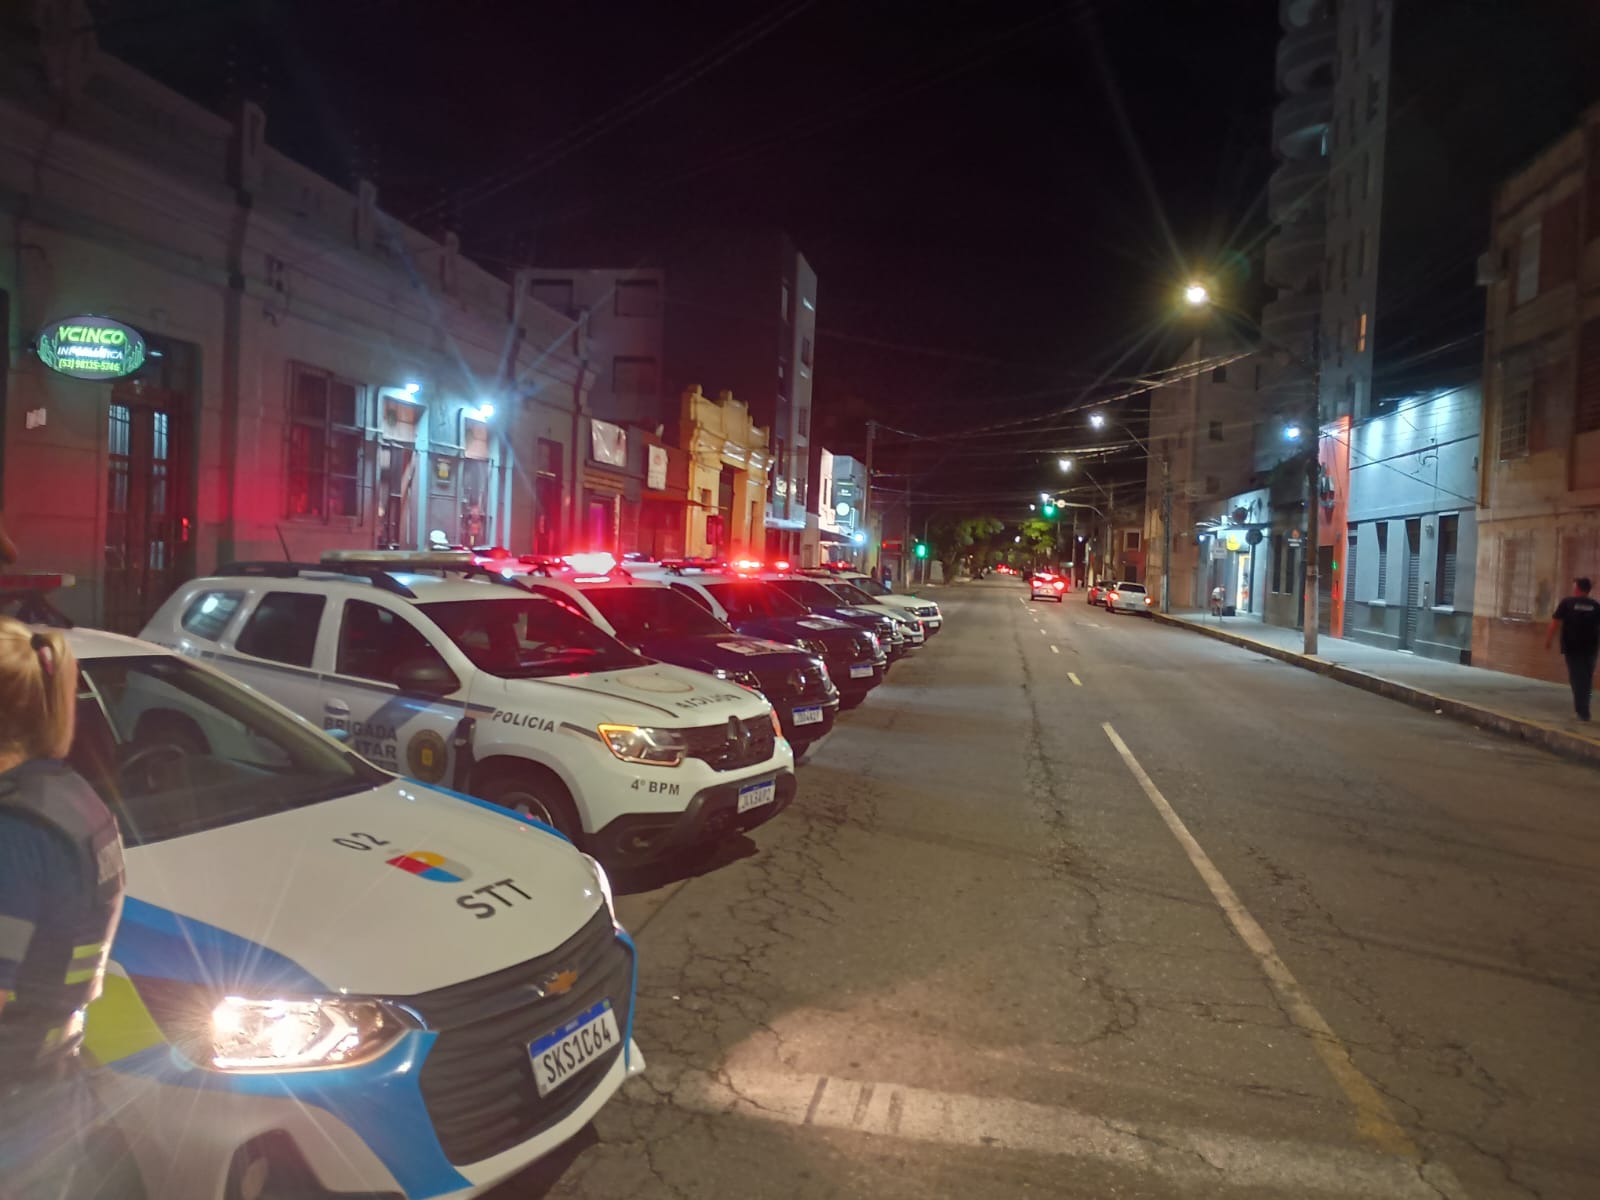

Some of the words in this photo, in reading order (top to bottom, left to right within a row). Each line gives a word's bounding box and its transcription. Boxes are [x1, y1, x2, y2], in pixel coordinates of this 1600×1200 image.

[59, 326, 124, 344] VCINCO
[492, 710, 555, 732] POLICIA
[649, 781, 680, 796] BPM
[332, 832, 390, 851] 02
[456, 878, 532, 919] STT
[543, 1018, 612, 1084] SKS1C64
